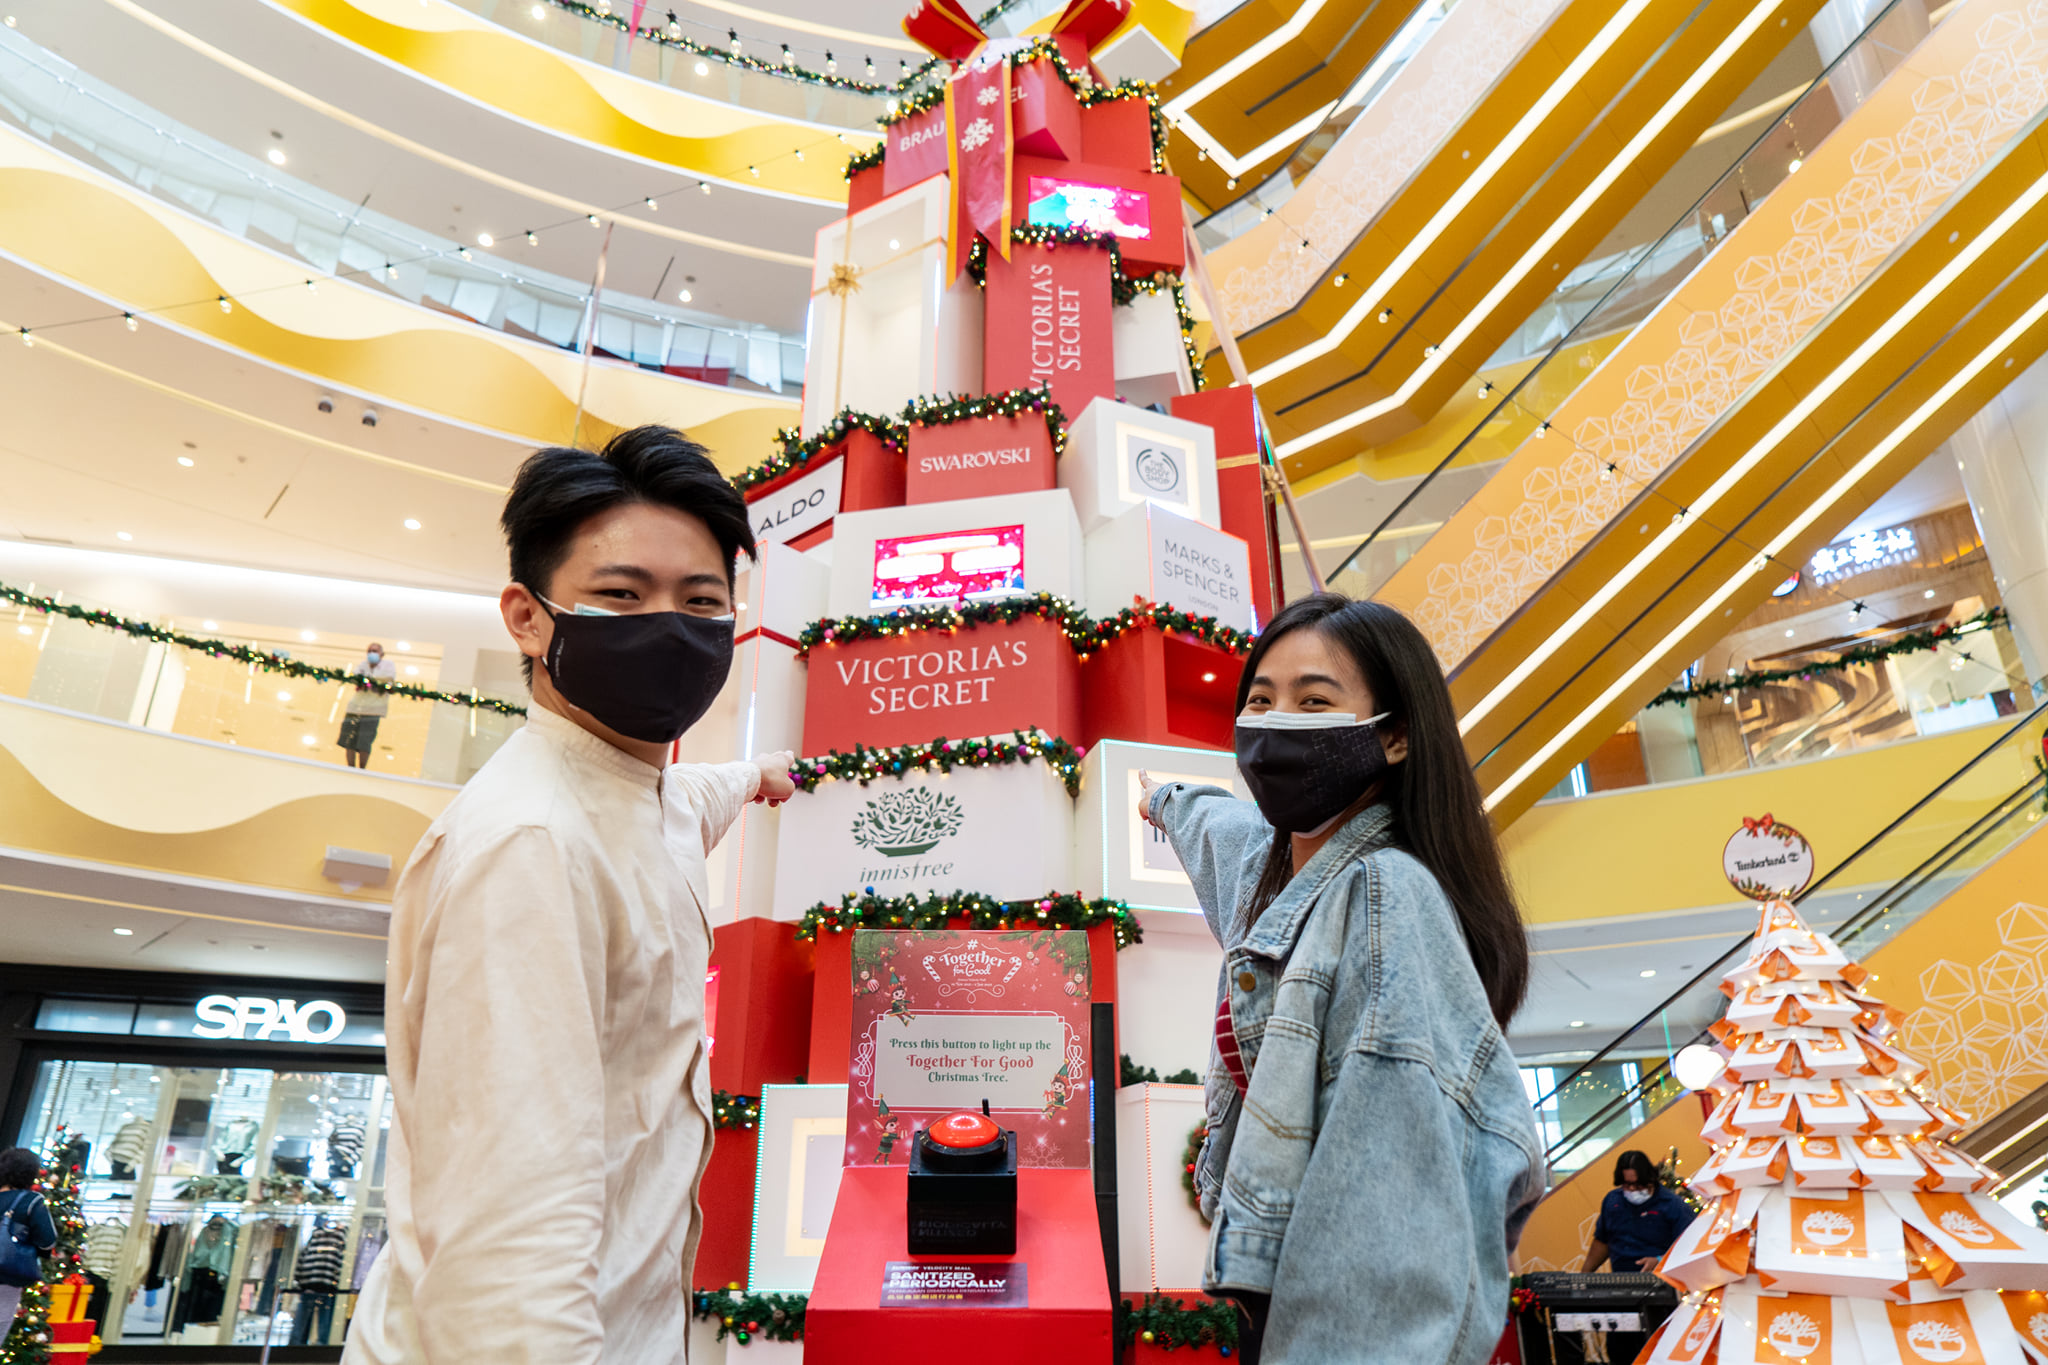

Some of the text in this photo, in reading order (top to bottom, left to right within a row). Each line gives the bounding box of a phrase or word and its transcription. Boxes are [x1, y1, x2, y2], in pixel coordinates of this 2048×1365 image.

[900, 120, 947, 152] BRAU
[1029, 263, 1054, 393] VICTORIA'S
[1057, 285, 1081, 372] SECRET
[919, 446, 1031, 473] SWAROVSKI
[757, 488, 825, 536] ALDO
[1164, 538, 1234, 580] MARKS &
[1162, 560, 1240, 604] SPENCER
[835, 640, 1029, 687] VICTORIA'S
[868, 676, 996, 715] SECRET
[859, 859, 955, 884] innisfree
[1734, 853, 1787, 872] Timberland
[938, 950, 1006, 968] Together
[952, 962, 992, 977] for Good
[192, 994, 346, 1045] SPAO
[889, 1038, 1052, 1053] Press this button to light up the
[906, 1054, 1034, 1072] Together For Good
[928, 1071, 1009, 1083] Christmas Tree.
[889, 1279, 1007, 1288] PERIODICALLY
[890, 1271, 976, 1280] SANITIZED
